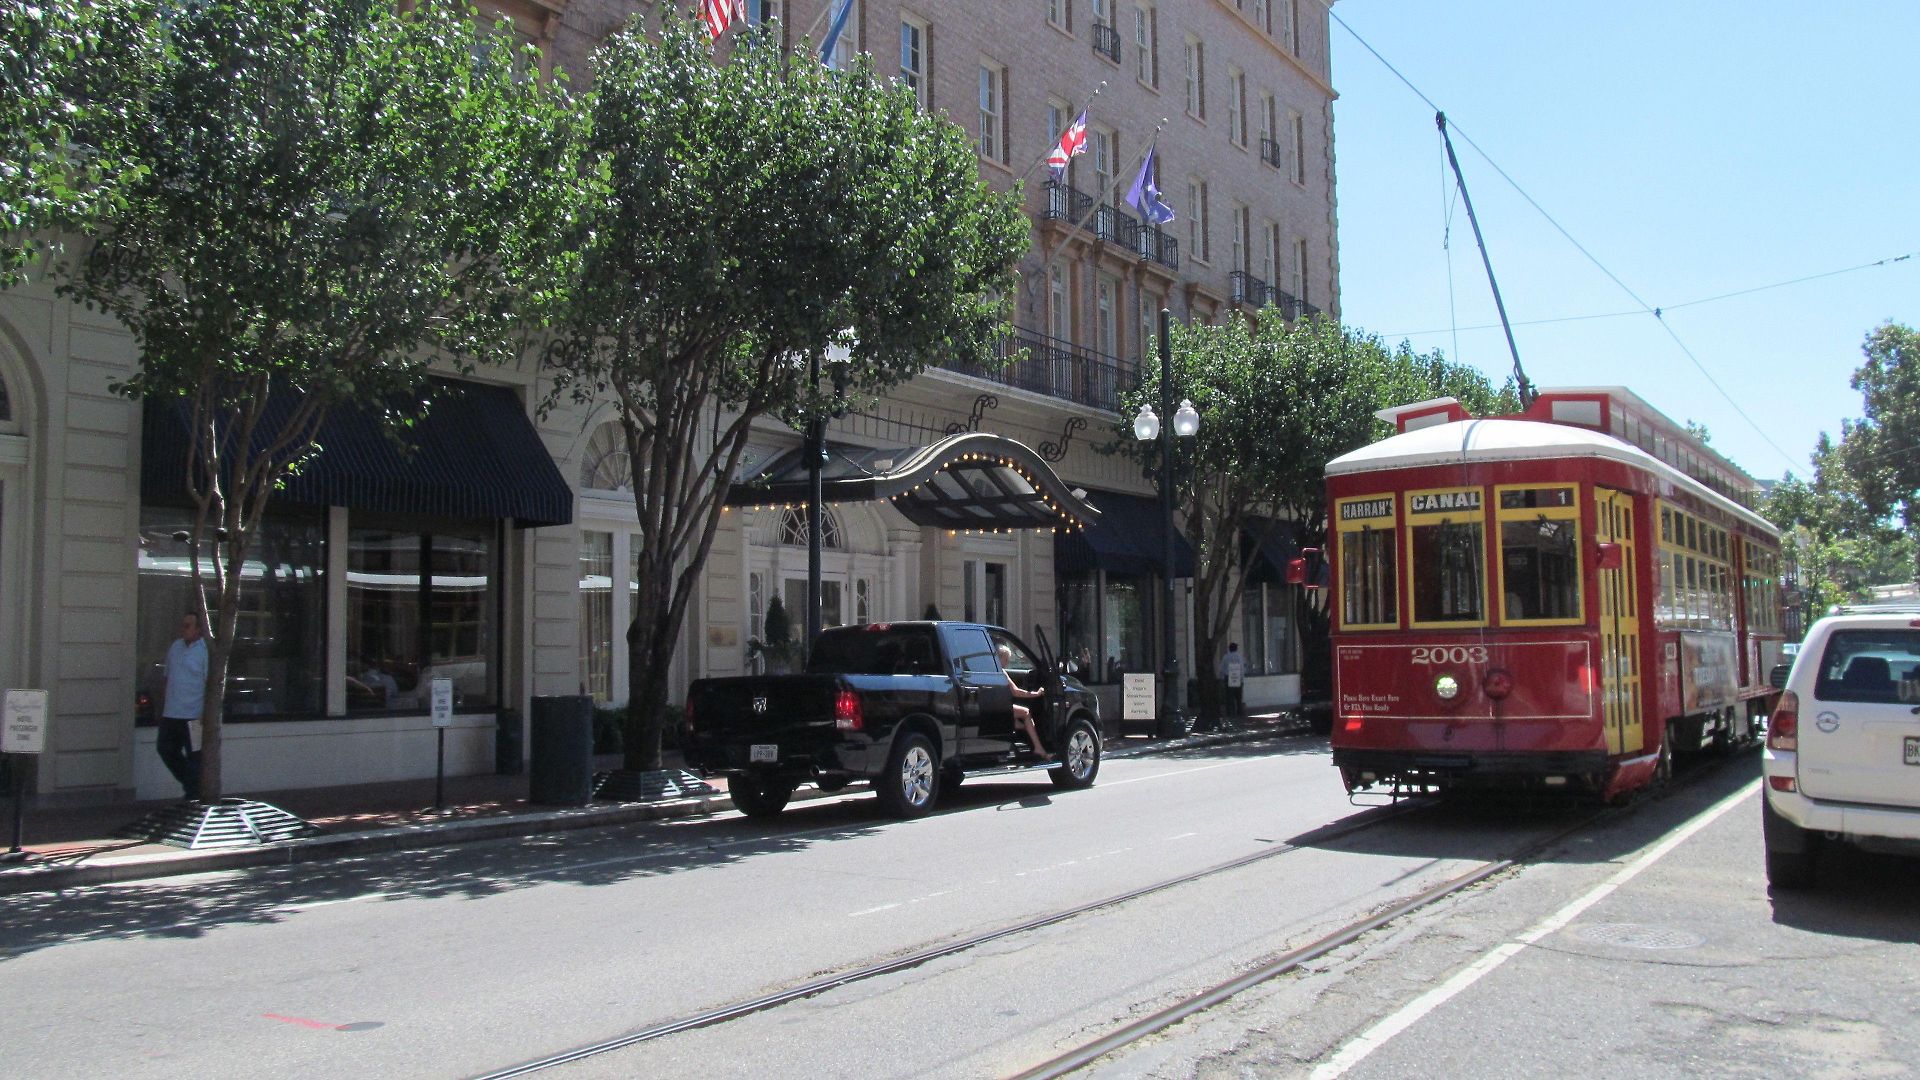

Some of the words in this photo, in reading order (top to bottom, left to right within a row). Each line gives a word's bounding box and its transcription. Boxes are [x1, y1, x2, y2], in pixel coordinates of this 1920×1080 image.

[1411, 492, 1480, 511] CANAL
[1558, 491, 1566, 505] 1
[1411, 646, 1489, 665] 2003
[1371, 694, 1386, 702] Exact
